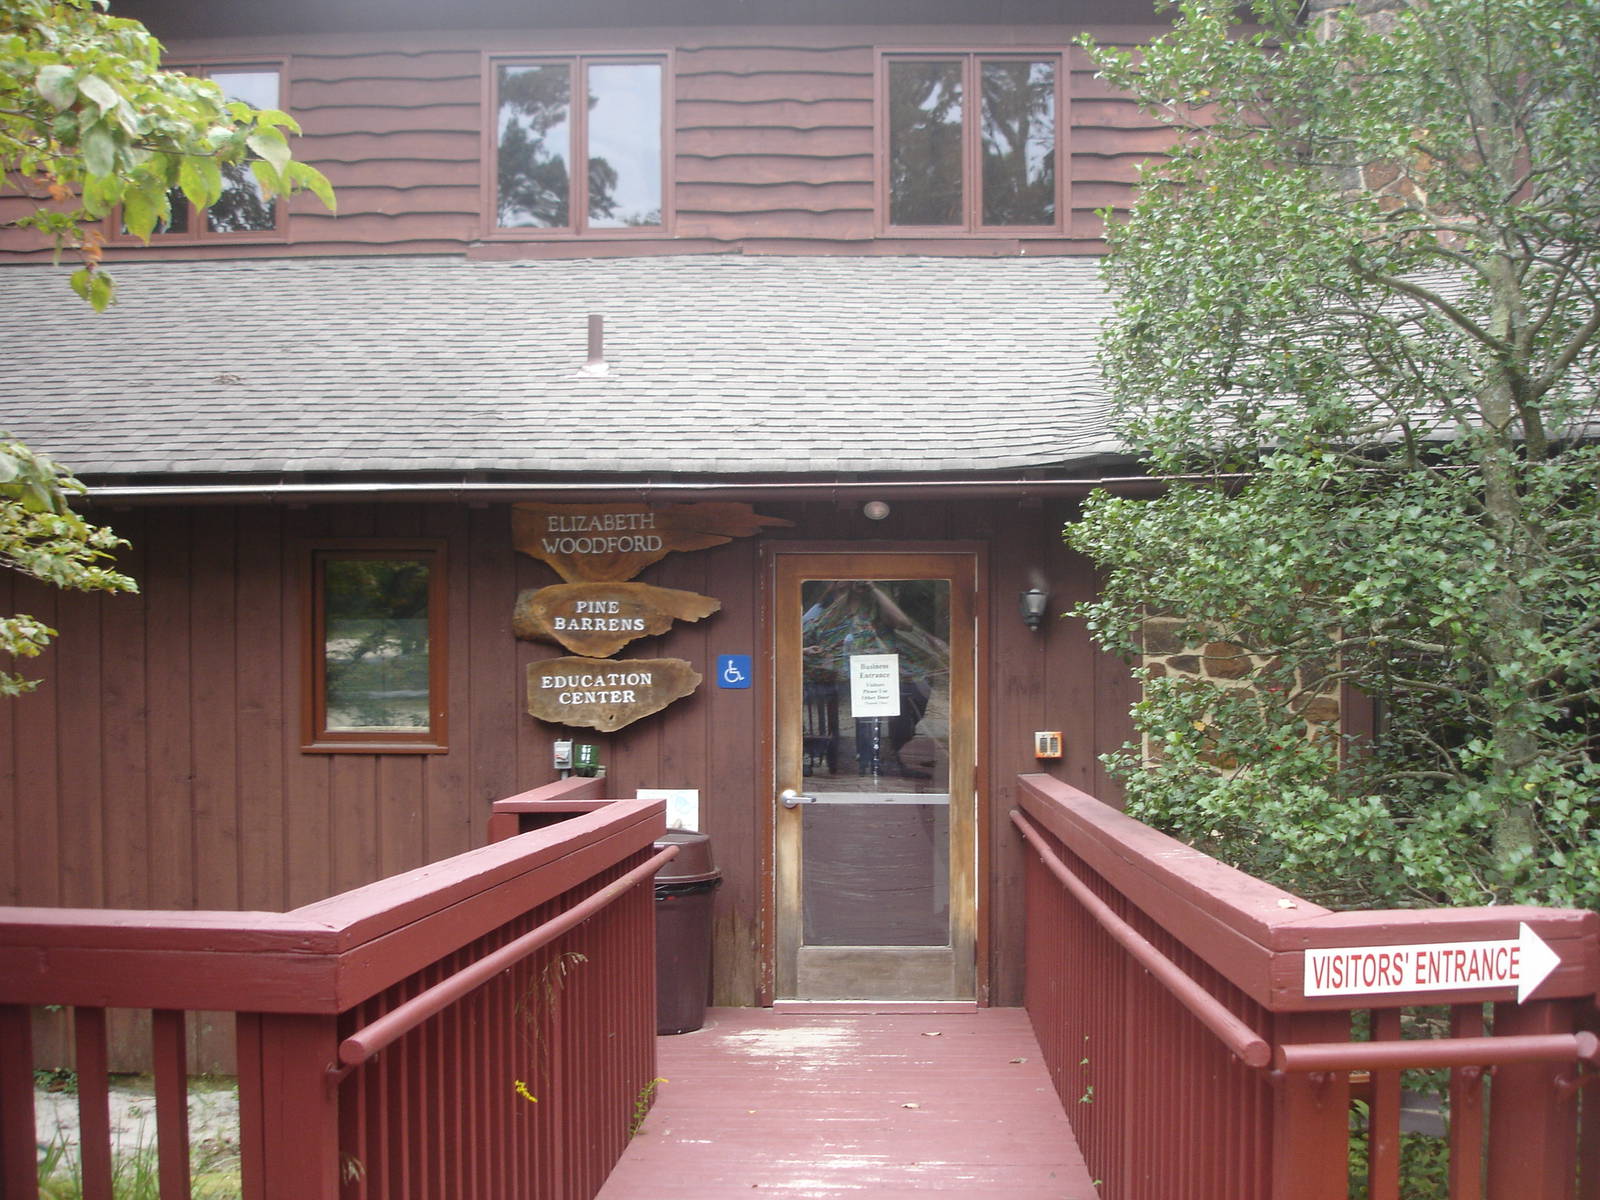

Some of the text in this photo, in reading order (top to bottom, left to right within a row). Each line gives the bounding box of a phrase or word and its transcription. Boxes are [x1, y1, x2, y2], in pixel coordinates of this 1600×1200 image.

[547, 512, 656, 533] ELIZABETH
[541, 534, 662, 554] WOODFORD
[575, 600, 620, 614] PINE
[553, 617, 645, 632] BARRENS
[541, 672, 653, 689] EDUCATION
[558, 689, 637, 705] CENTER
[1312, 946, 1521, 990] VISITORS' ENTRANCE
